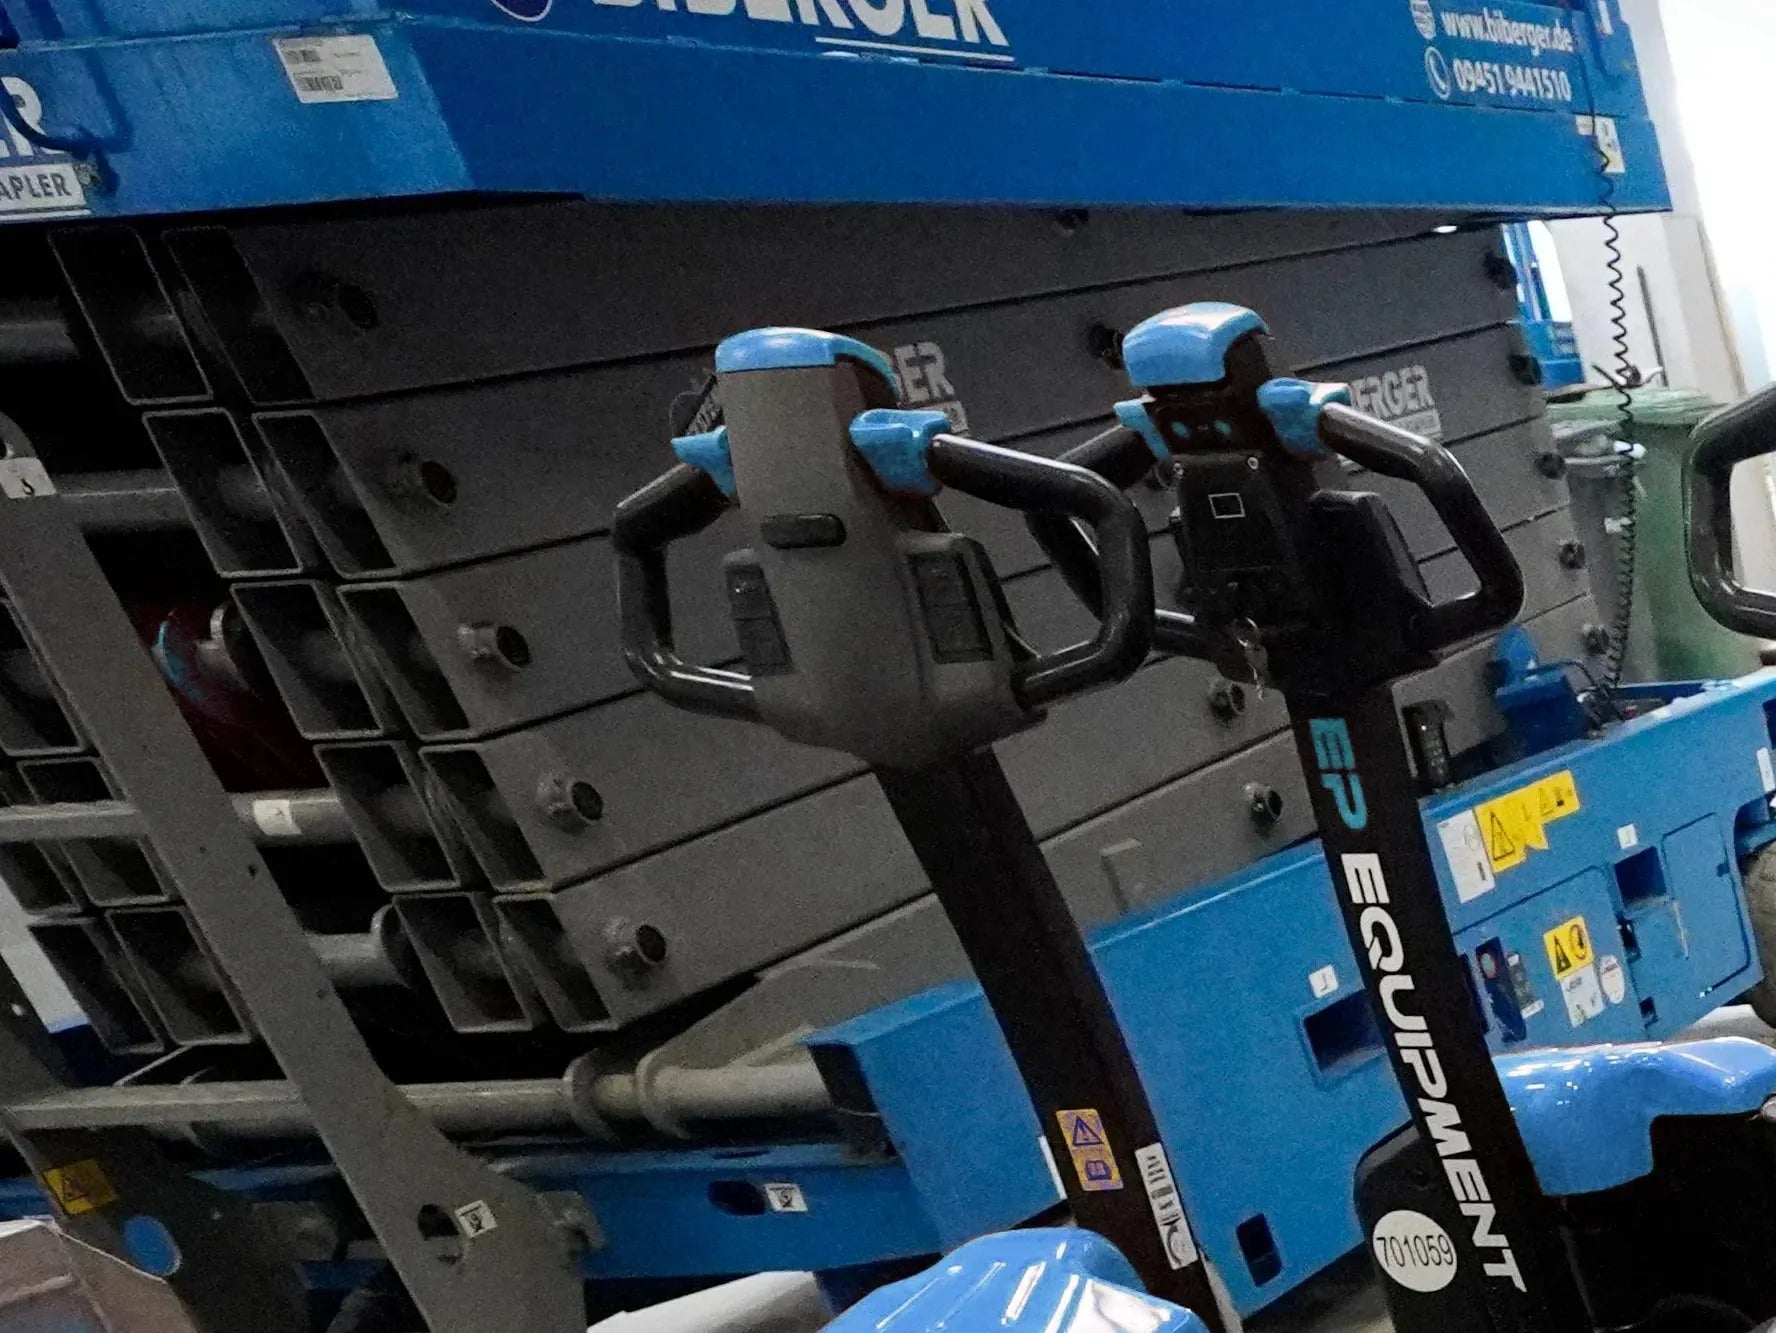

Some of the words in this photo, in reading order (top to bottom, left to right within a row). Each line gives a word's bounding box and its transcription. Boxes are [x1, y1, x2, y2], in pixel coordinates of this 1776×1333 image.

[1309, 718, 1369, 831] EP
[1341, 853, 1528, 1293] EQUIPMENT
[1376, 1235, 1454, 1268] 701059
